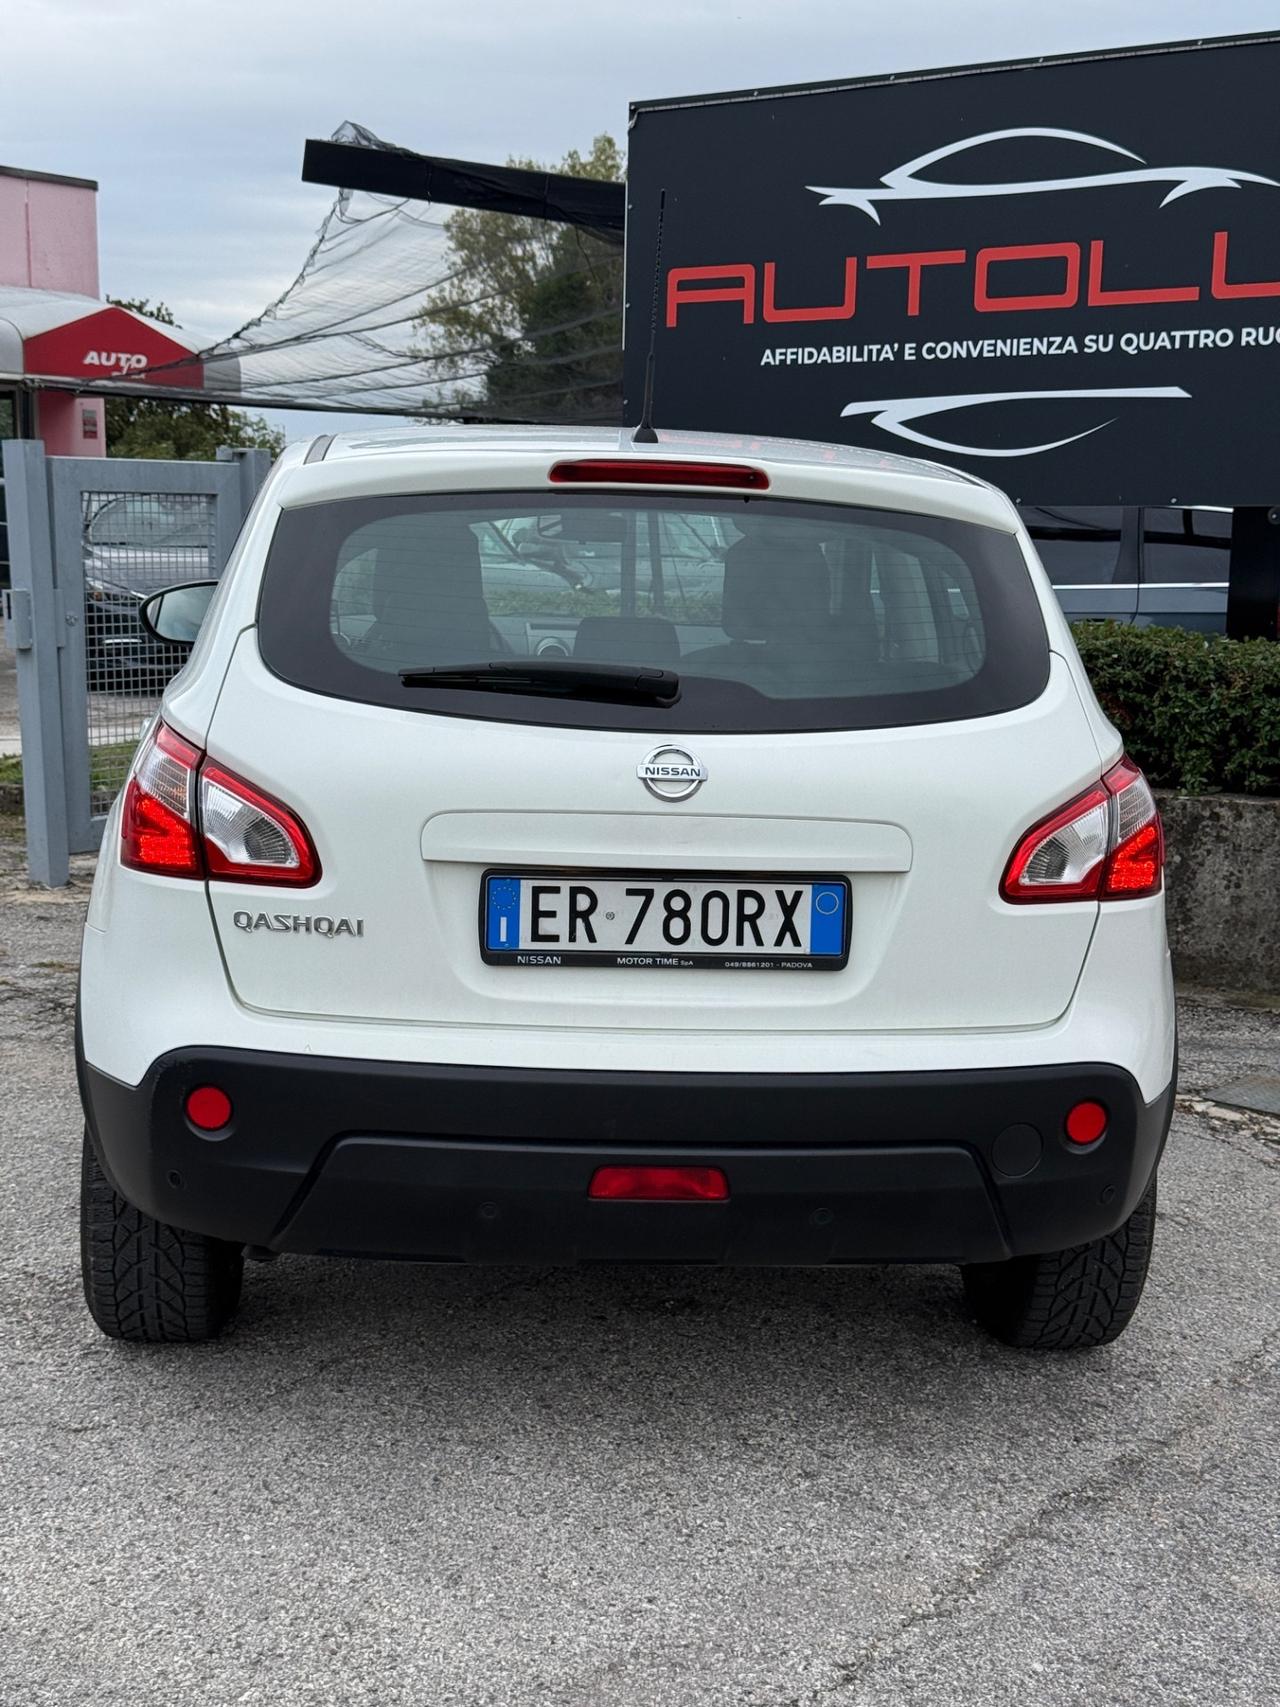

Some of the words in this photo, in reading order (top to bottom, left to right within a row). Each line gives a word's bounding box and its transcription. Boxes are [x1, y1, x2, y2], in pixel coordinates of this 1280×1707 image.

[904, 343, 917, 360] E
[921, 336, 1079, 360] CONVENIENZA
[1083, 333, 1114, 353] SU
[1119, 328, 1234, 355] QUATTRO
[1240, 326, 1280, 347] RU
[83, 350, 148, 369] AUTO
[645, 767, 701, 777] NISSAN
[233, 910, 364, 938] QASHQAI
[530, 885, 598, 943] ER
[624, 888, 804, 947] 780RX
[516, 955, 562, 965] NISSAN
[617, 957, 653, 965] MOTOR
[655, 958, 679, 966] TIME
